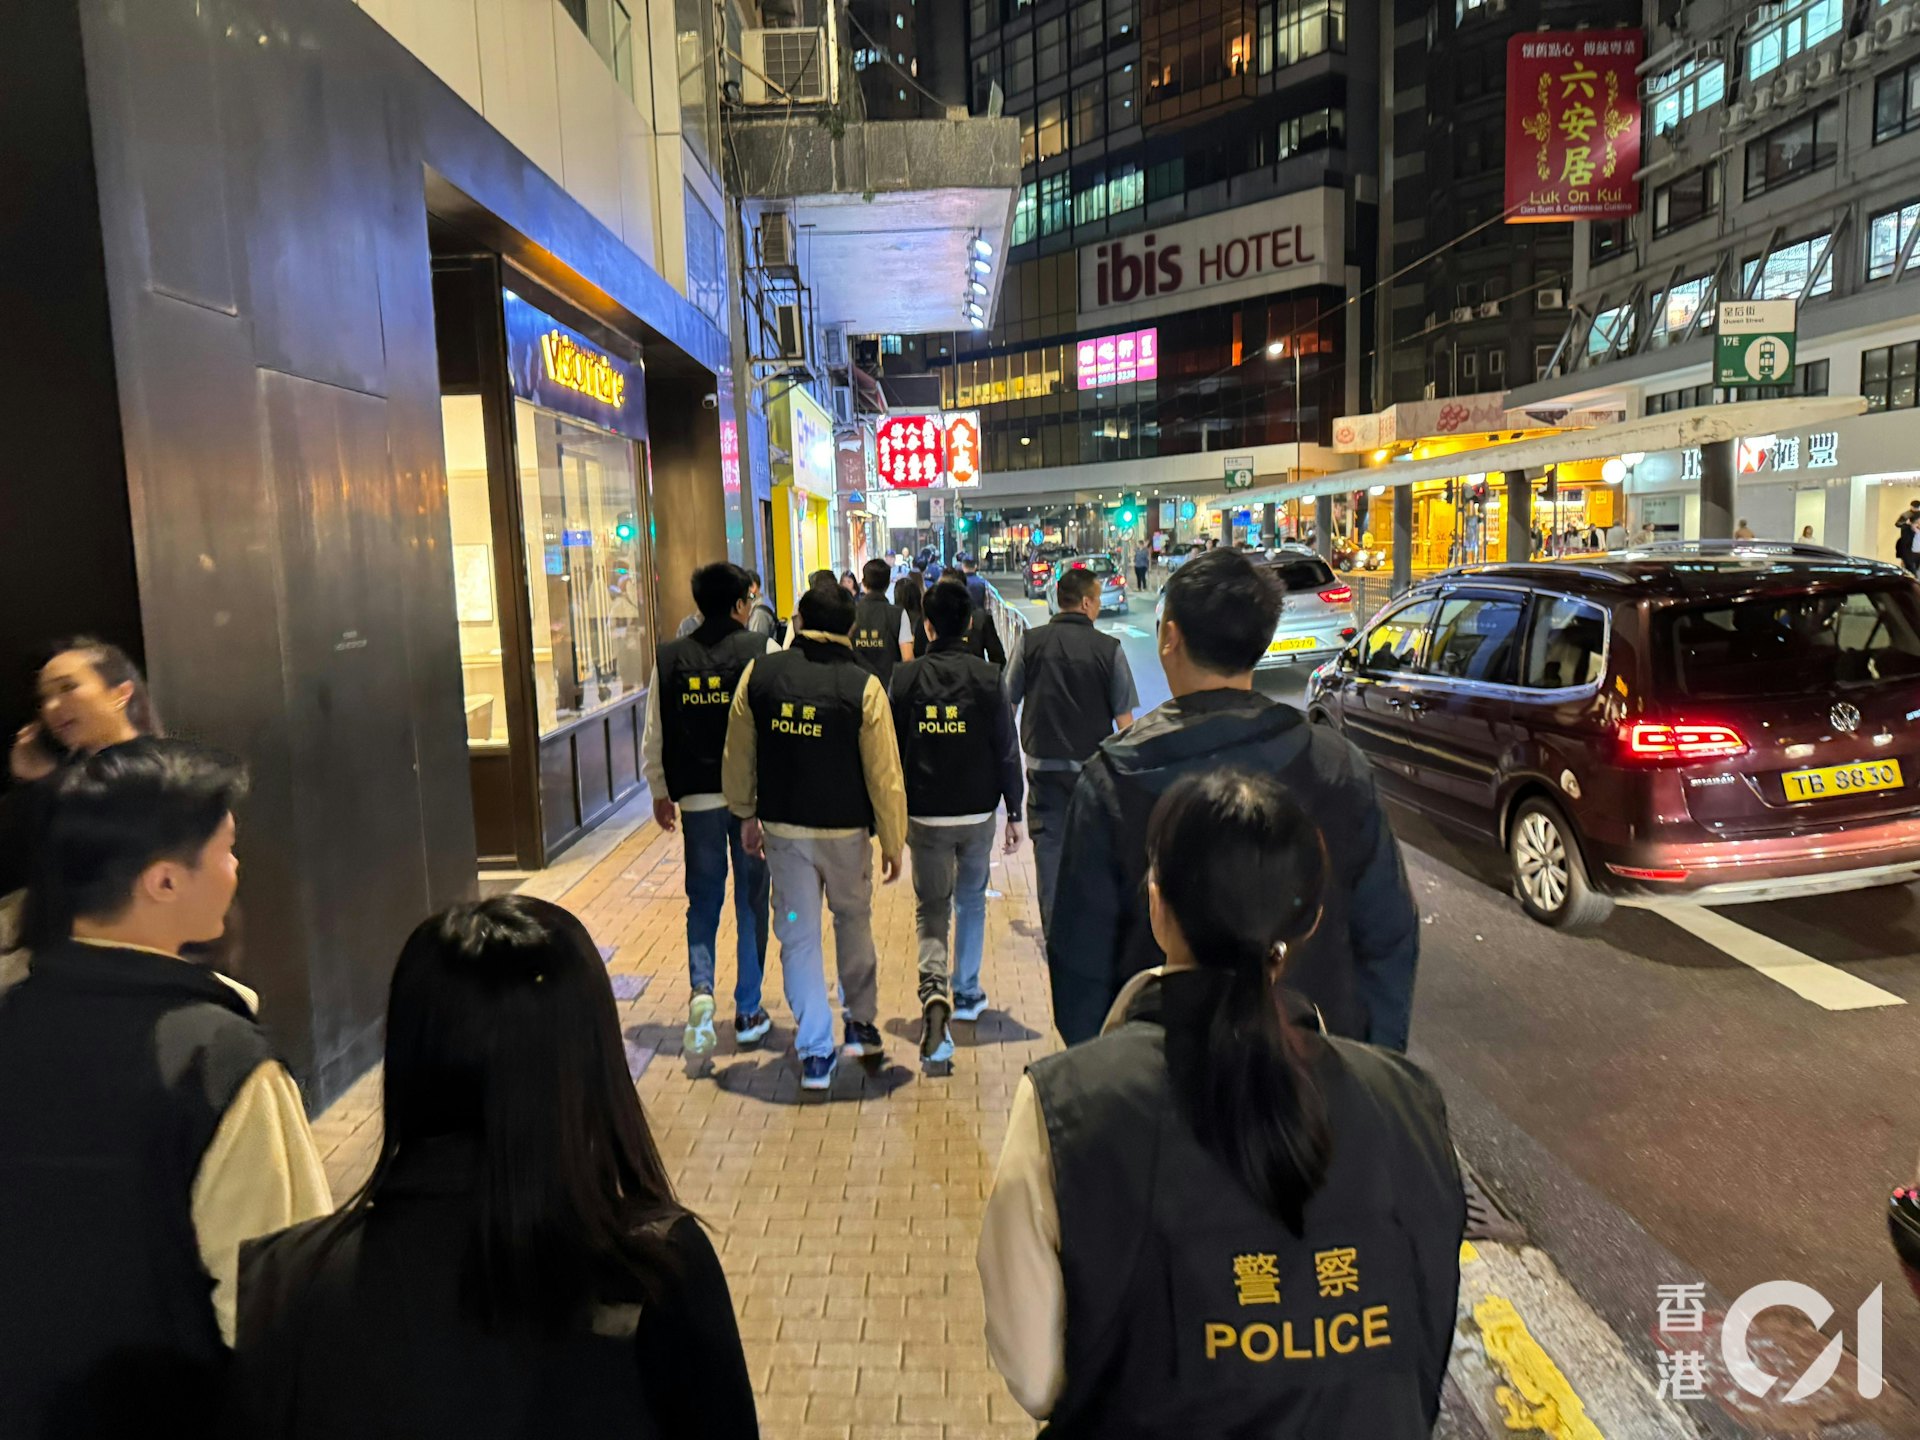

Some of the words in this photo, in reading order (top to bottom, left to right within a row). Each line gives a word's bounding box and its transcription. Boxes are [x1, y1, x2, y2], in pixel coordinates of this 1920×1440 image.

[1558, 61, 1599, 186] 六安居
[1530, 190, 1559, 205] Luk
[1568, 190, 1589, 204] On
[1597, 188, 1622, 202] Kui
[1520, 205, 1536, 214] Dim
[1538, 205, 1555, 213] Sum
[1563, 203, 1603, 212] Cantonese
[1604, 203, 1632, 211] Cuisine
[1096, 234, 1184, 306] ibis
[1199, 225, 1316, 285] HOTEL
[1724, 306, 1755, 317] 皇后街
[1723, 317, 1744, 325] Queen
[1723, 336, 1740, 346] 17E
[856, 639, 884, 648] POLICE
[688, 676, 721, 691] 警察
[682, 692, 730, 705] POLICE
[780, 703, 817, 720] 警察
[925, 706, 958, 719] 警察
[771, 718, 822, 737] POLICE
[918, 721, 966, 734] POLICE
[1791, 774, 1826, 796] TB
[1836, 765, 1895, 790] 8830
[1232, 1247, 1361, 1307] 警察
[1204, 1305, 1393, 1363] POLICE
